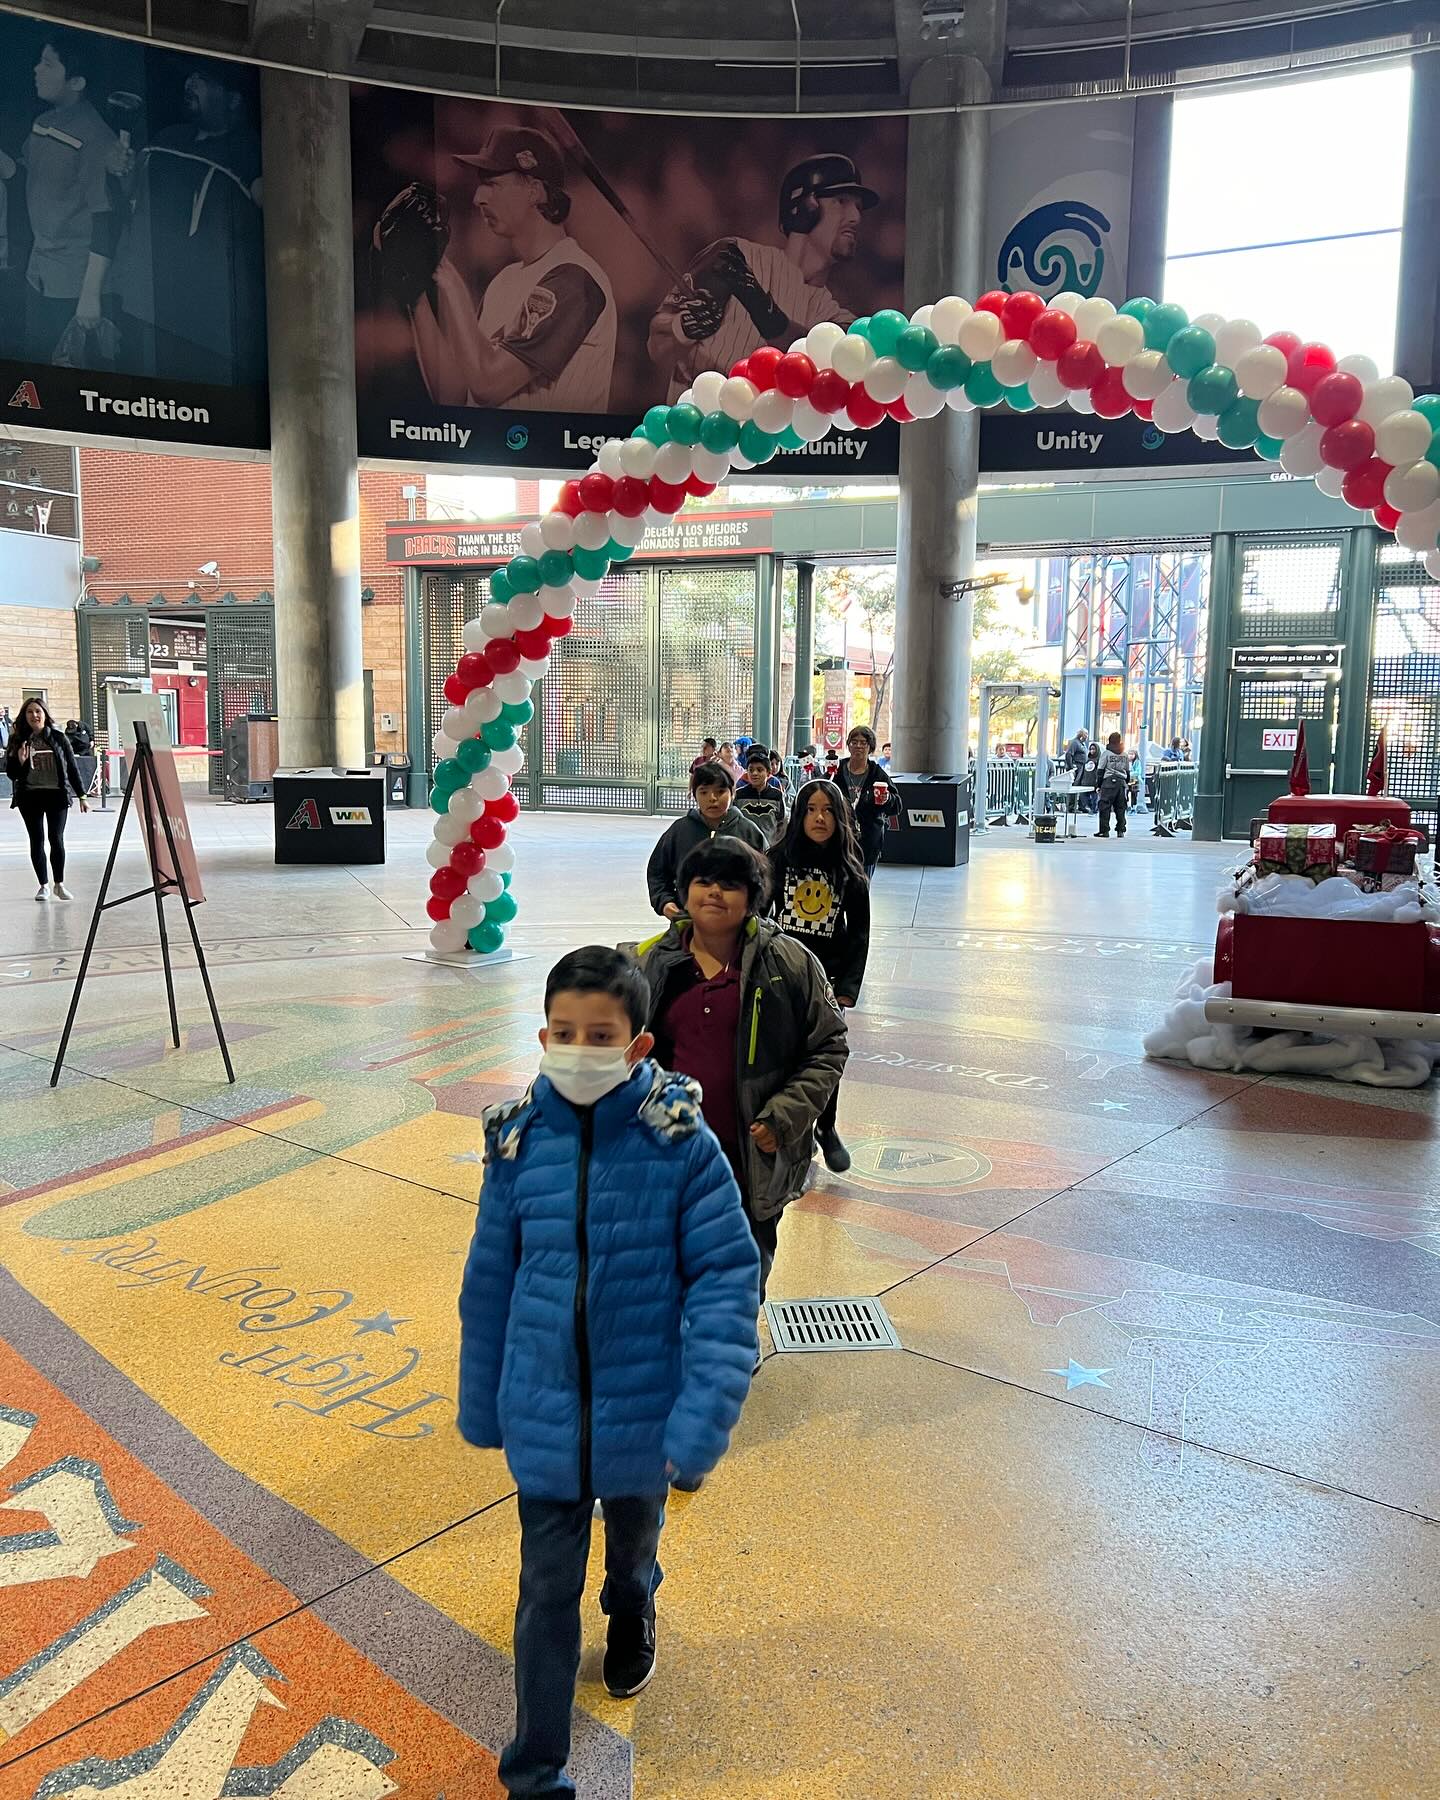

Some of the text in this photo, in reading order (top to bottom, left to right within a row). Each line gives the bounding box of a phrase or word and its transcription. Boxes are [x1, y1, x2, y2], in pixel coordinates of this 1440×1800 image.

[79, 389, 210, 424] Tradition
[389, 419, 472, 449] Family
[563, 430, 630, 456] Leg
[1036, 430, 1104, 454] Unity
[676, 525, 684, 537] A
[685, 524, 703, 536] LOS
[705, 522, 749, 536] MEJORES
[457, 535, 486, 547] THANK
[487, 533, 504, 545] THE
[682, 537, 700, 549] DEL
[702, 534, 742, 548] BÉISBOL
[457, 546, 479, 557] FANS
[480, 545, 490, 556] IN
[1269, 655, 1288, 663] please
[1263, 733, 1297, 747] EXIT
[336, 811, 366, 821] WM
[913, 813, 941, 823] WM
[79, 1236, 354, 1334] COUNTRY
[218, 1345, 452, 1440] HIGH
